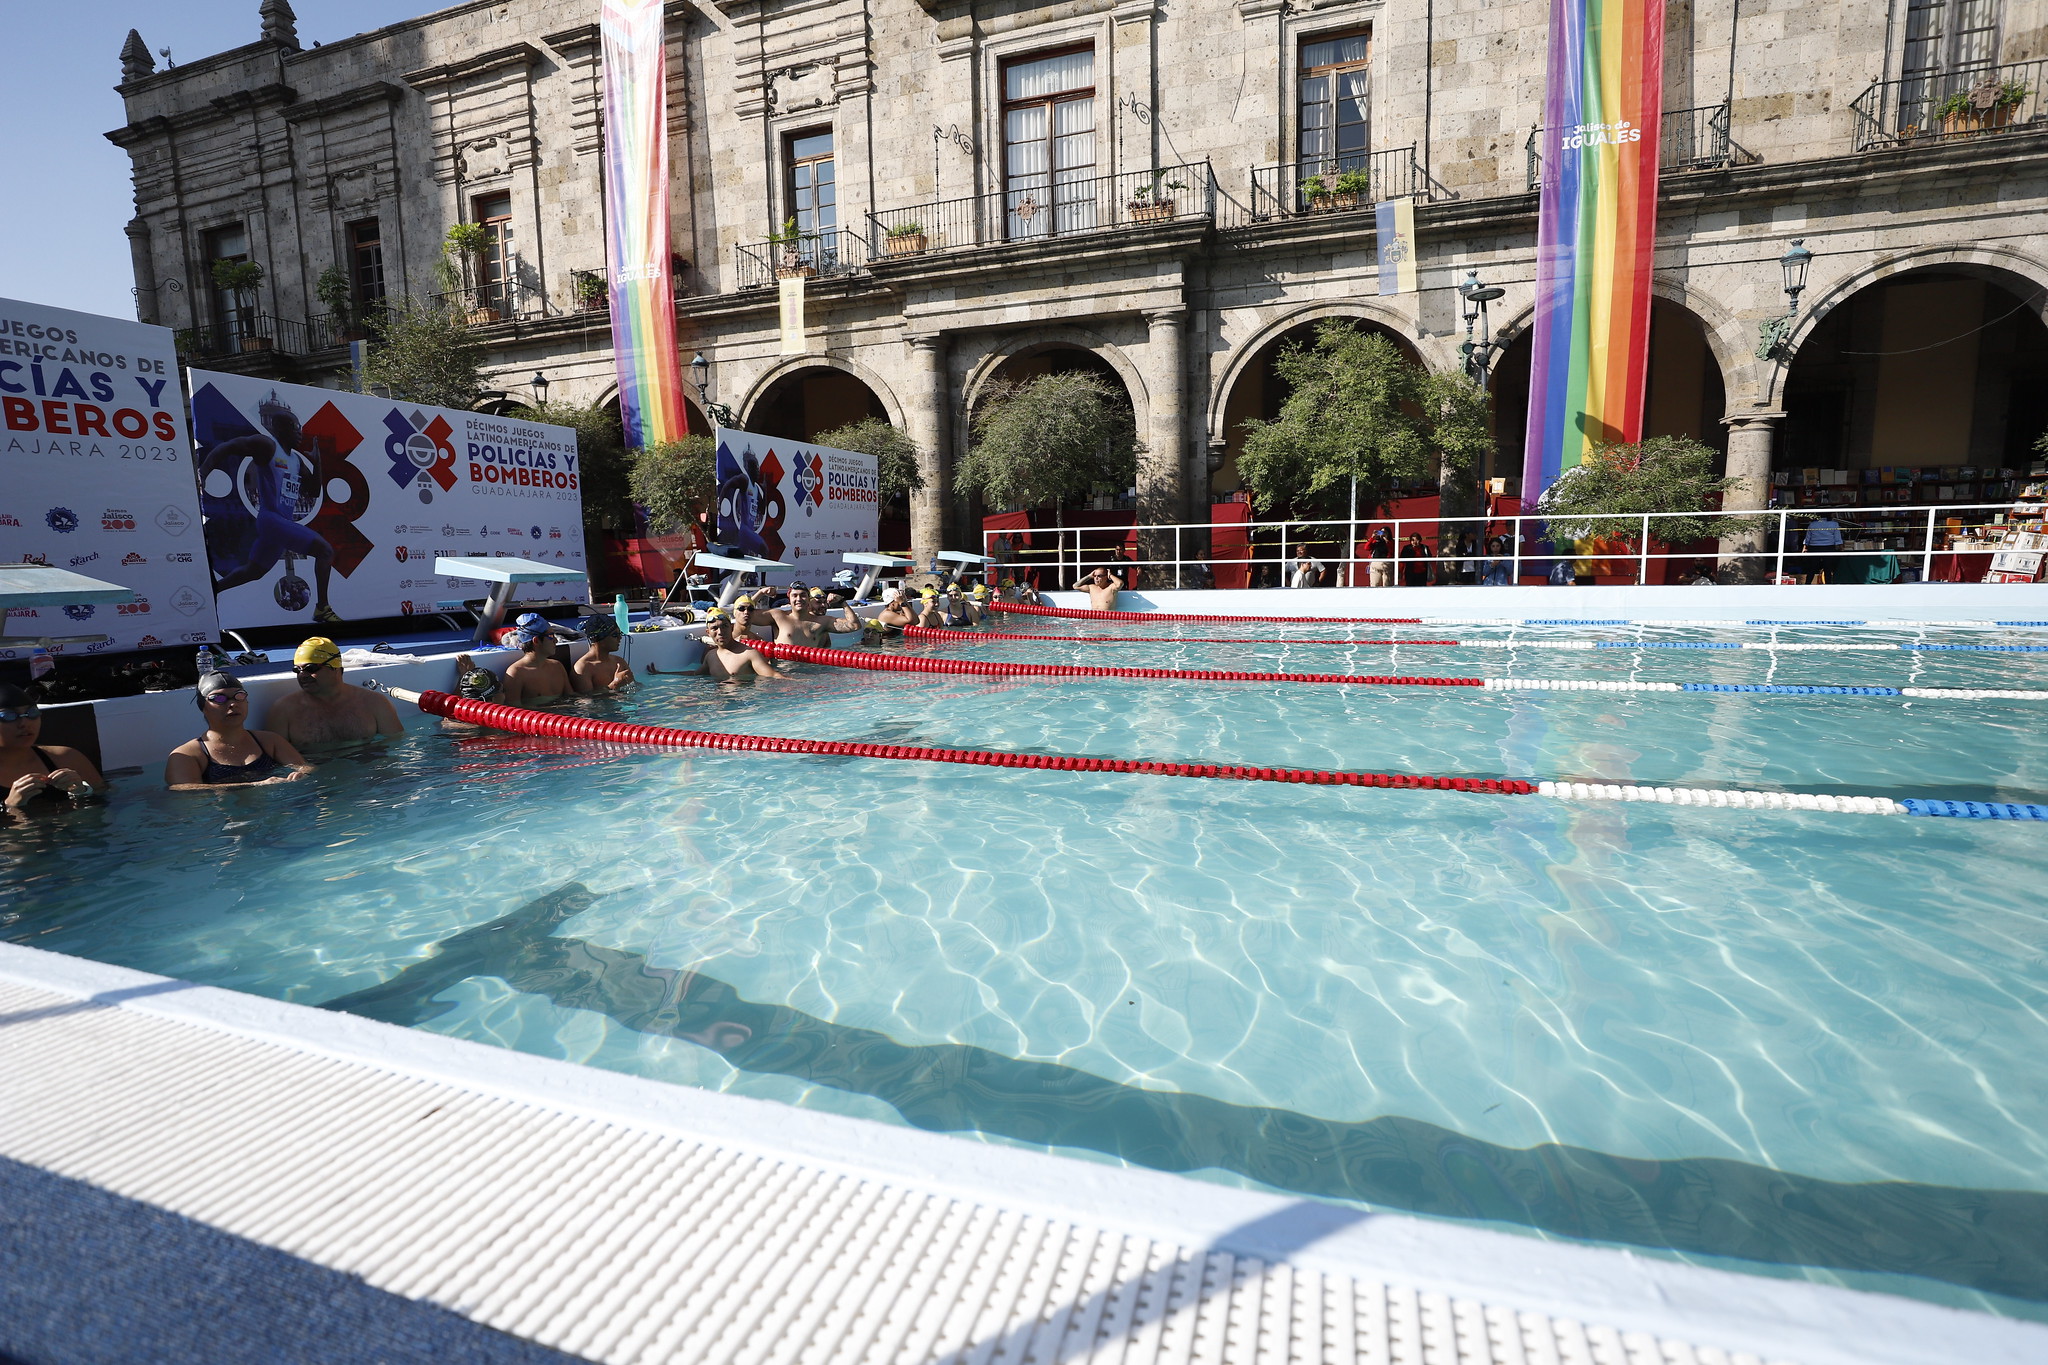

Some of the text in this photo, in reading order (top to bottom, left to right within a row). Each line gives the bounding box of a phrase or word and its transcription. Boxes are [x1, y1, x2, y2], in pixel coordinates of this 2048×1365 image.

[1573, 120, 1631, 134] Jalisco de
[1562, 128, 1641, 150] IGUALES
[617, 267, 661, 284] IGUALES
[0, 338, 166, 375] ERICANOS DE
[0, 355, 167, 408] CÍAS Y
[2, 395, 176, 442] BEROS
[466, 418, 545, 439] DÉCIMOS JUEGOS
[7, 437, 178, 462] AJARA 2023
[467, 431, 575, 454] LATINOAMERICANOS DE
[467, 442, 576, 472] POLICÍAS Y
[469, 462, 578, 490] BOMBEROS
[828, 471, 877, 489] POLICÍAS Y
[472, 485, 578, 501] GUADALAJARA 2023
[828, 486, 877, 503] BOMBEROS
[101, 512, 133, 520] Jalisco
[101, 519, 136, 530] 200
[69, 551, 99, 567] Starch
[116, 602, 151, 614] 200
[86, 635, 116, 654] Starch
